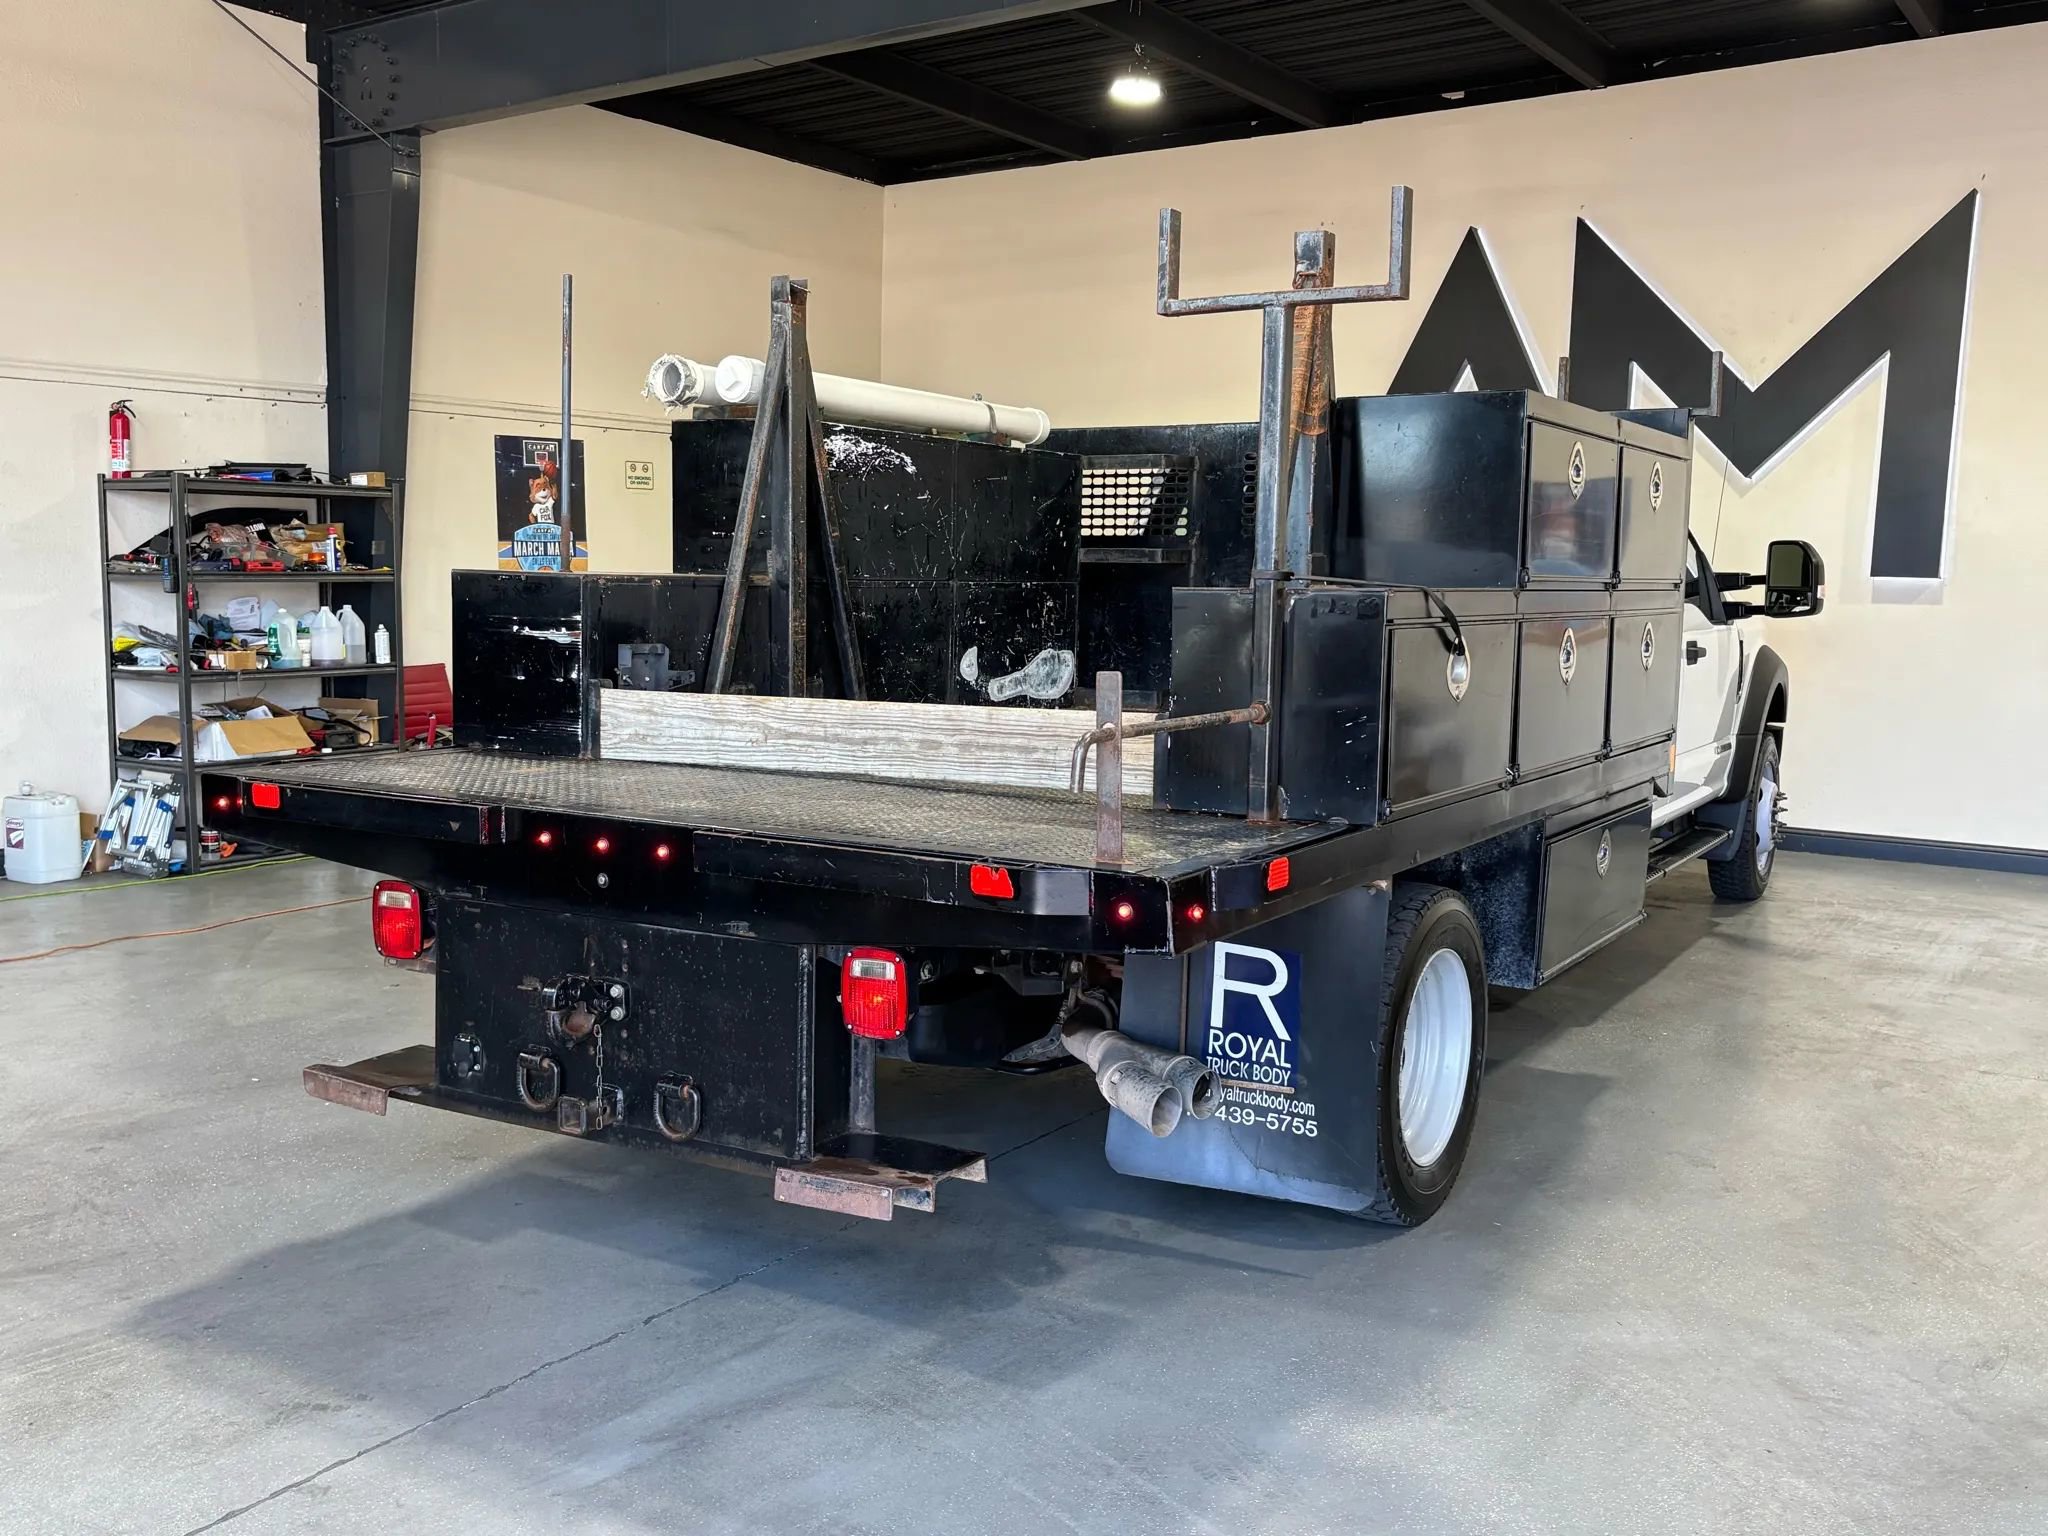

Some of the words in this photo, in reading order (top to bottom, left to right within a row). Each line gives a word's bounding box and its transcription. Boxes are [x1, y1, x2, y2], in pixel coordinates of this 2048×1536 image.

[540, 506, 550, 514] CAR
[514, 541, 544, 557] MARCH
[547, 541, 574, 557] MAA
[1210, 941, 1292, 1041] R
[1208, 1029, 1292, 1068] ROYAL
[1206, 1056, 1249, 1080] TRUCK
[1252, 1064, 1291, 1087] BODY
[1220, 1085, 1315, 1117] yaltruckbody.com
[1214, 1105, 1318, 1138] 439-5755
